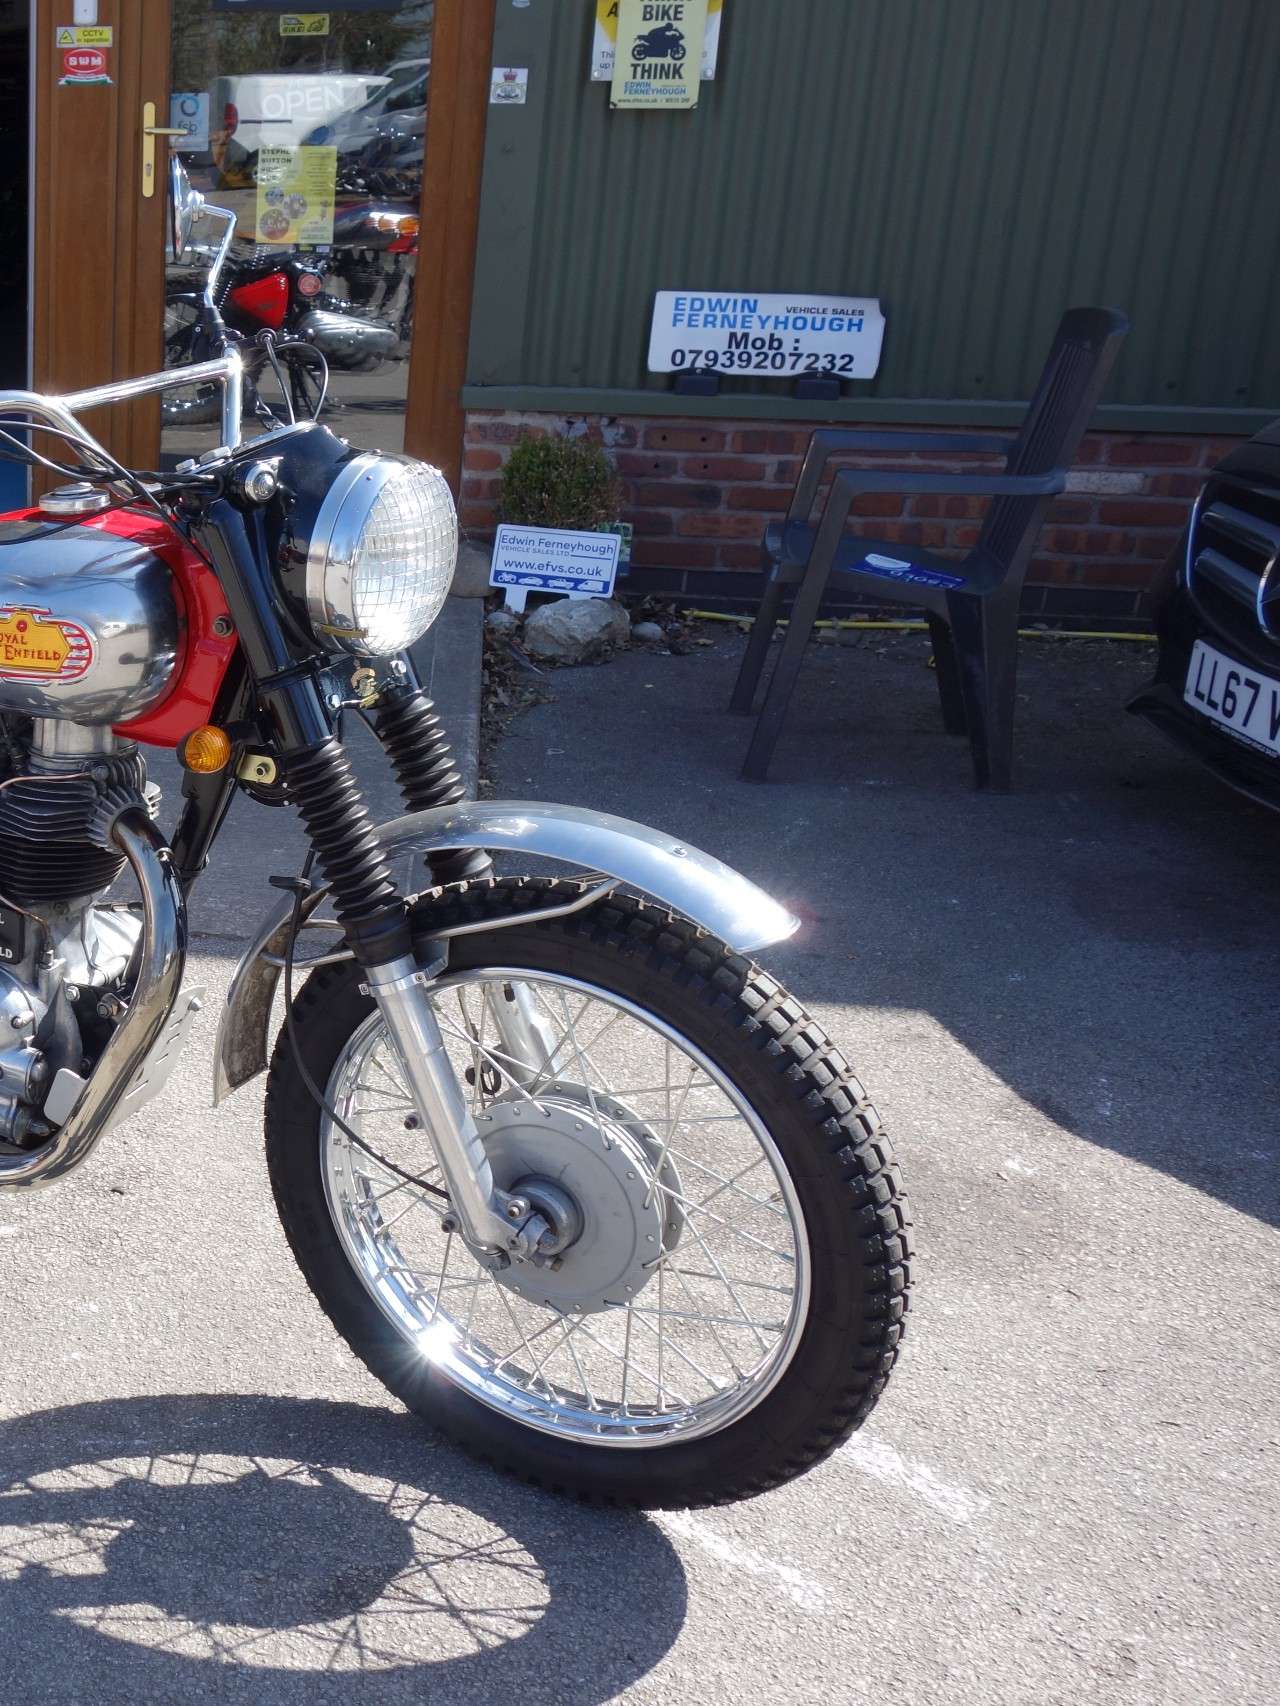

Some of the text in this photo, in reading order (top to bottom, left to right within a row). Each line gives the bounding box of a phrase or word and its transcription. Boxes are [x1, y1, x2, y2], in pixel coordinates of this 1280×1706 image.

[642, 4, 684, 21] BIKE
[631, 63, 685, 80] THINK
[261, 84, 345, 119] OPEN
[673, 297, 758, 314] EDWIN
[786, 306, 865, 316] VEHICLE SALES
[672, 312, 864, 333] FERNEYHOUGH
[727, 332, 783, 351] Mob
[670, 349, 855, 373] 07939207232
[500, 545, 530, 553] VEHICLE
[532, 548, 555, 556] SALES
[501, 535, 614, 556] Edwin Ferneyhough
[504, 559, 603, 577] www.efvs.co.uk
[5, 644, 61, 661] ENFIELD
[1194, 652, 1261, 728] LL67
